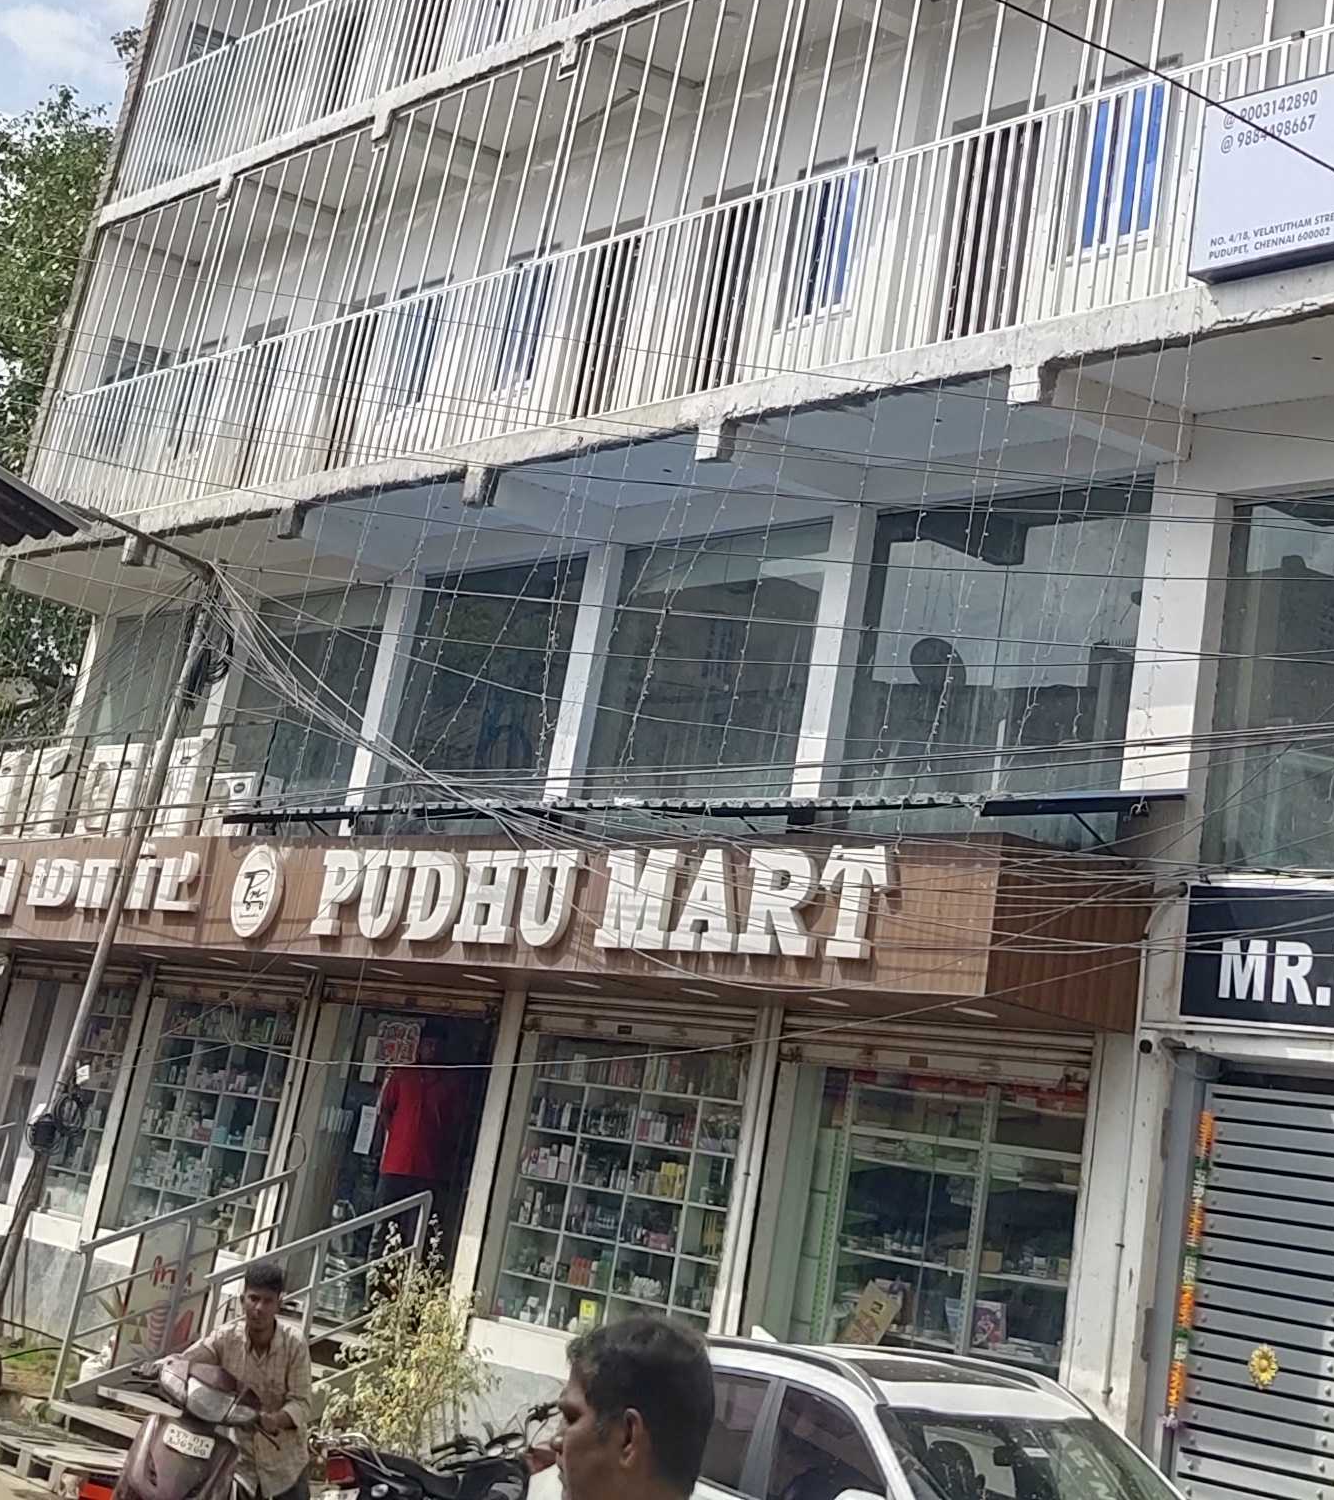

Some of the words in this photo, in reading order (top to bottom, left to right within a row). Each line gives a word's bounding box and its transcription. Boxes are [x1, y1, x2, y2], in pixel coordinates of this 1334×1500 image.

[1254, 219, 1311, 238] VELAYUTHAM
[1254, 233, 1295, 250] CHENNAI
[26, 842, 200, 913] மார்ட்
[309, 848, 586, 947] PUDHU
[593, 845, 892, 959] MART
